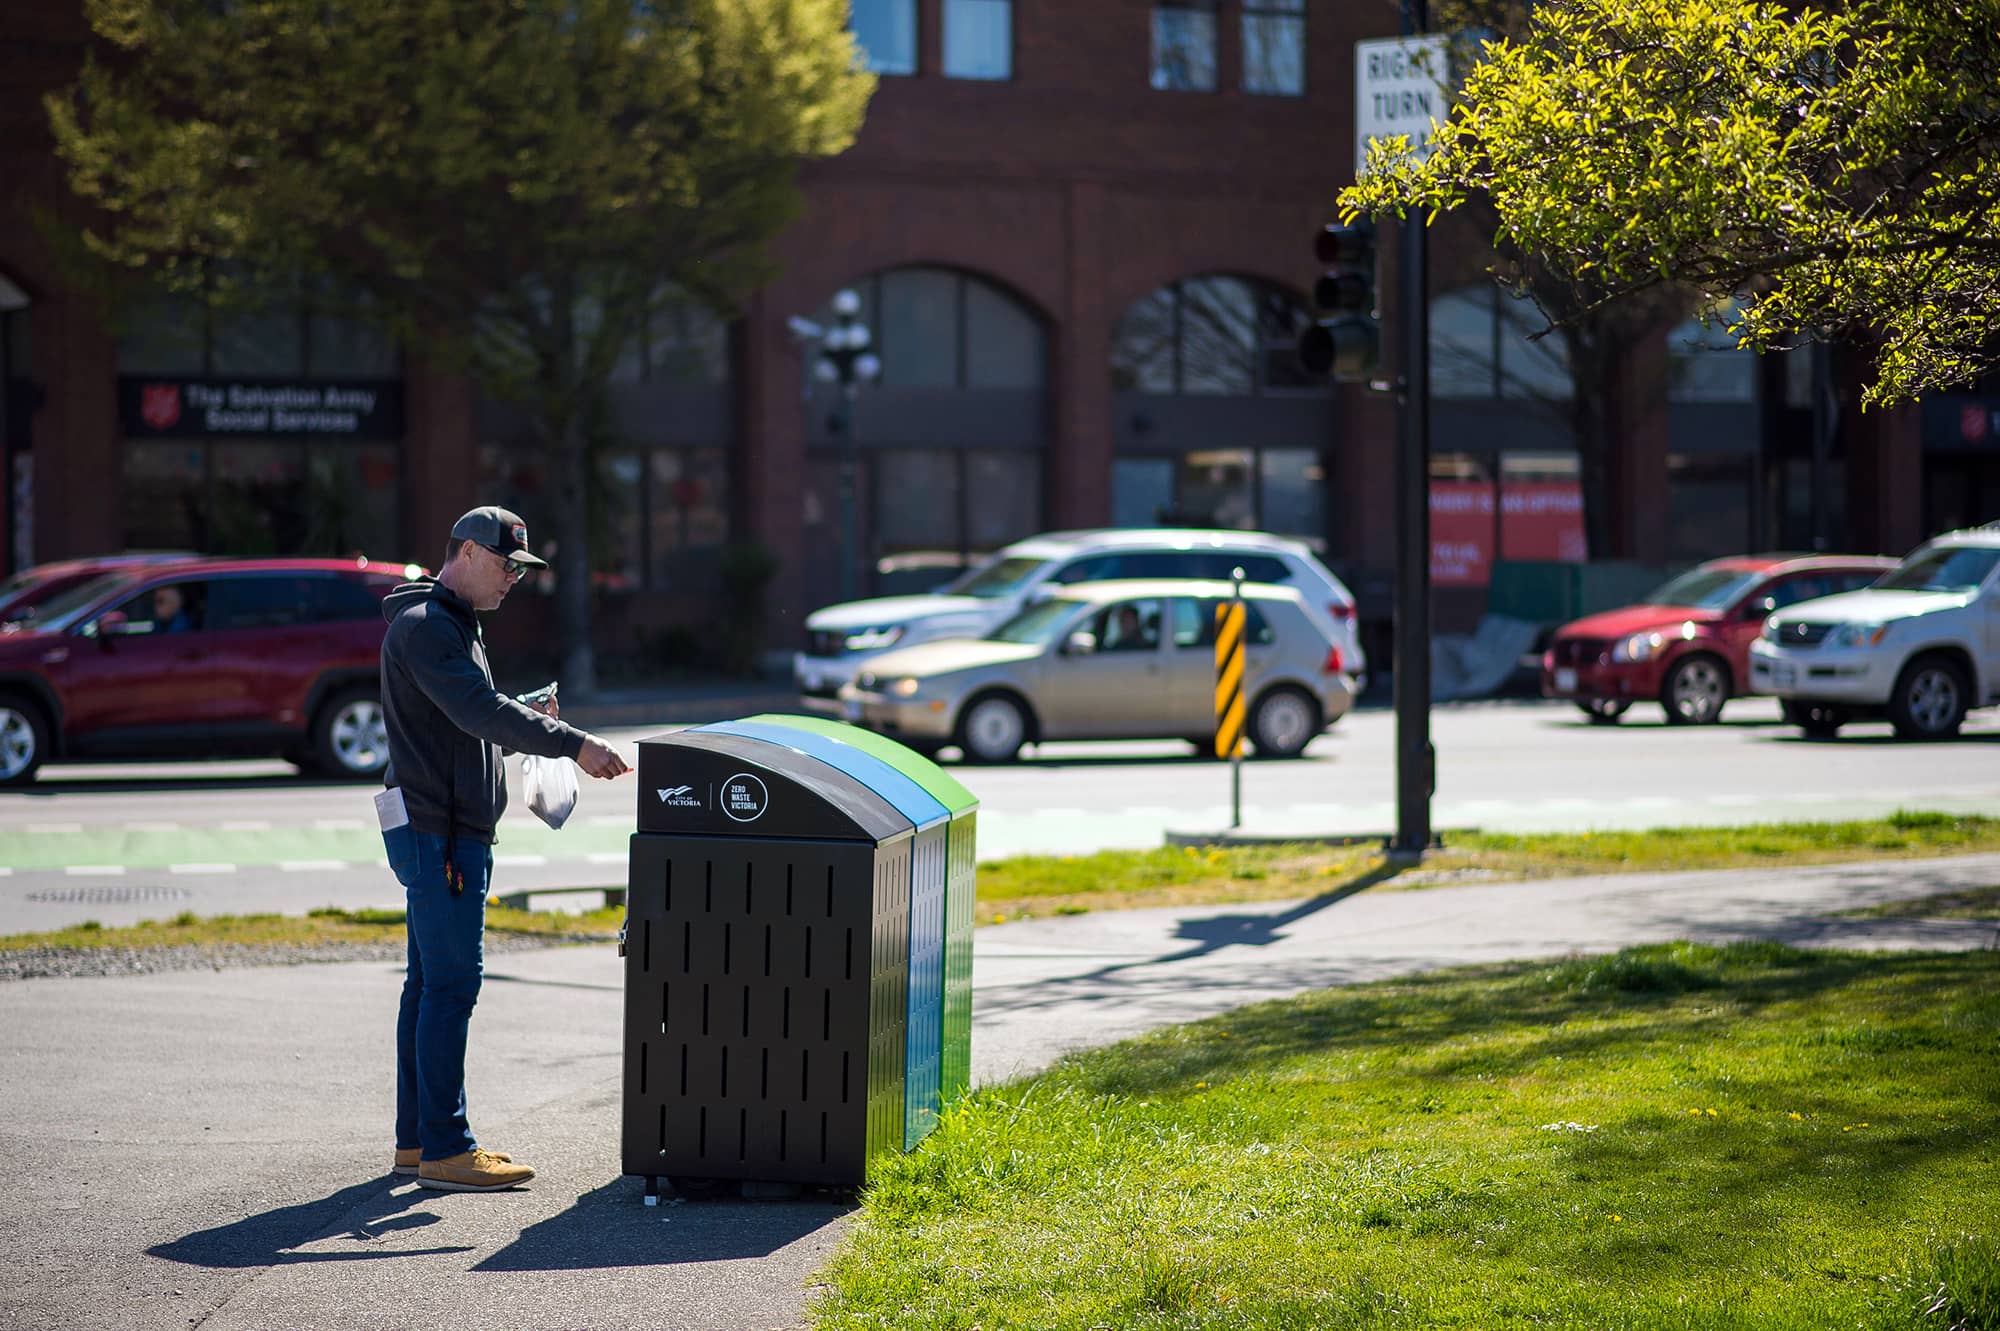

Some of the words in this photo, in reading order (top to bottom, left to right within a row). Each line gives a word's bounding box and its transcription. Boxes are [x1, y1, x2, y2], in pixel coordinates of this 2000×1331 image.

[1372, 90, 1433, 120] TURN
[186, 384, 224, 407] The
[228, 385, 321, 408] Salvation
[324, 386, 376, 415] Army
[206, 409, 269, 432] Social
[271, 409, 358, 432] Services
[731, 785, 746, 793] ZERO
[731, 802, 757, 810] VICTORIA
